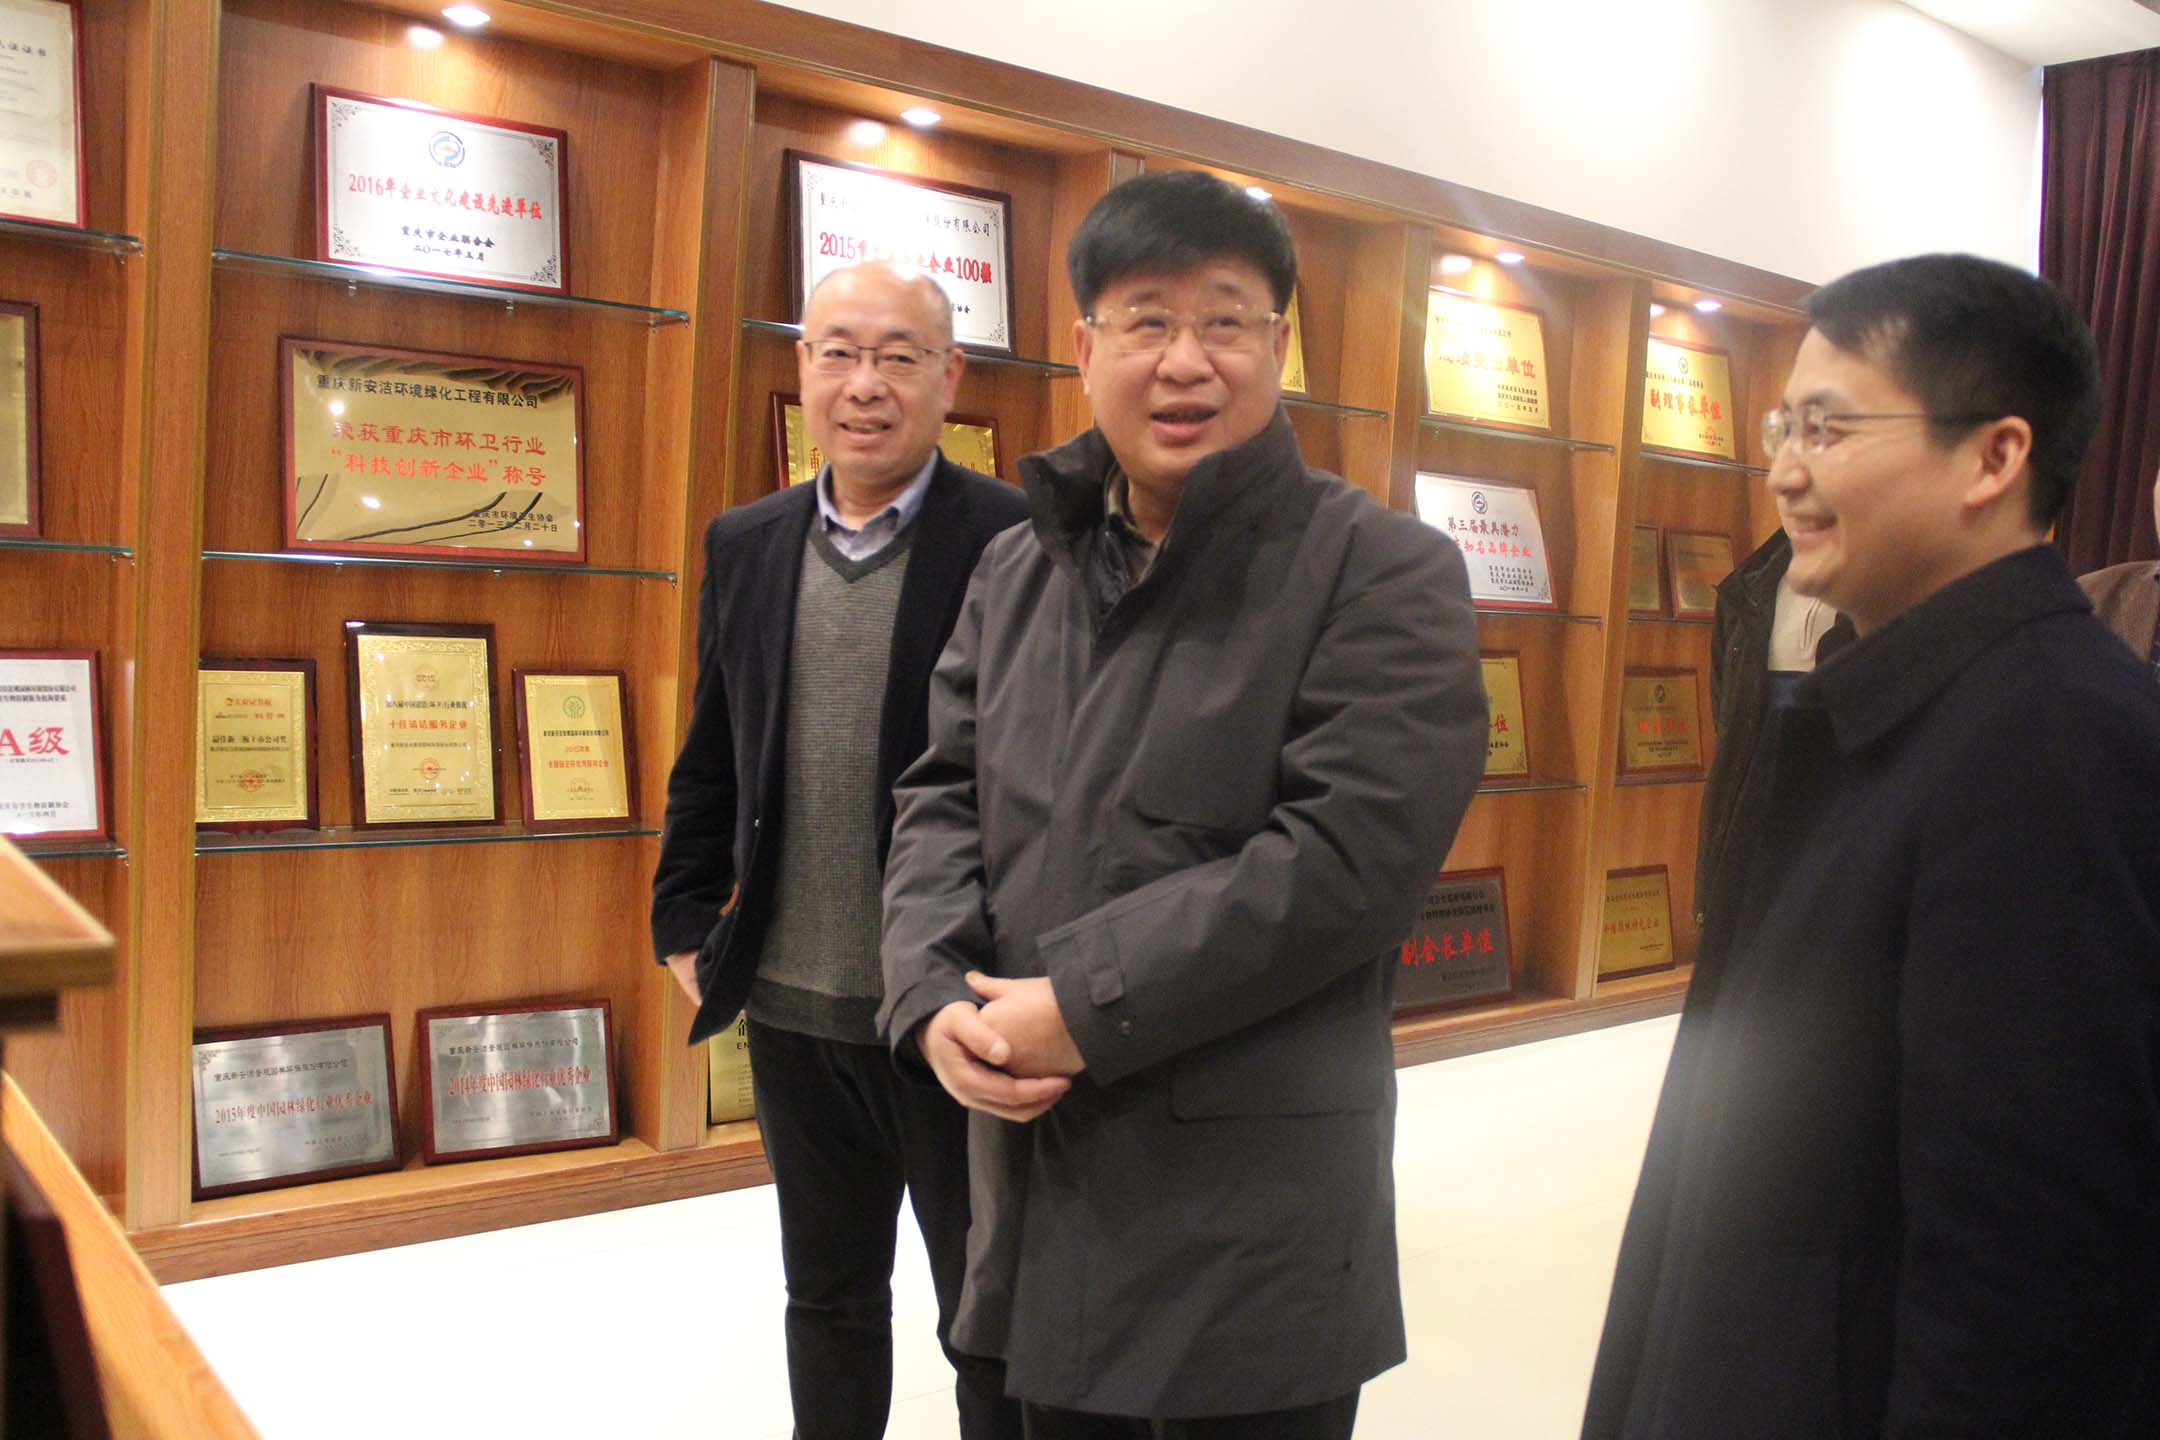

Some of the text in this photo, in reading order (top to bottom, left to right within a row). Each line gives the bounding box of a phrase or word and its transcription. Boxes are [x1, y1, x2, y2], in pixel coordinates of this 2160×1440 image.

[317, 373, 539, 409] 重庆新安洁环境绿化工程有限公司
[332, 422, 547, 456] 荣获重庆市环卫行业
